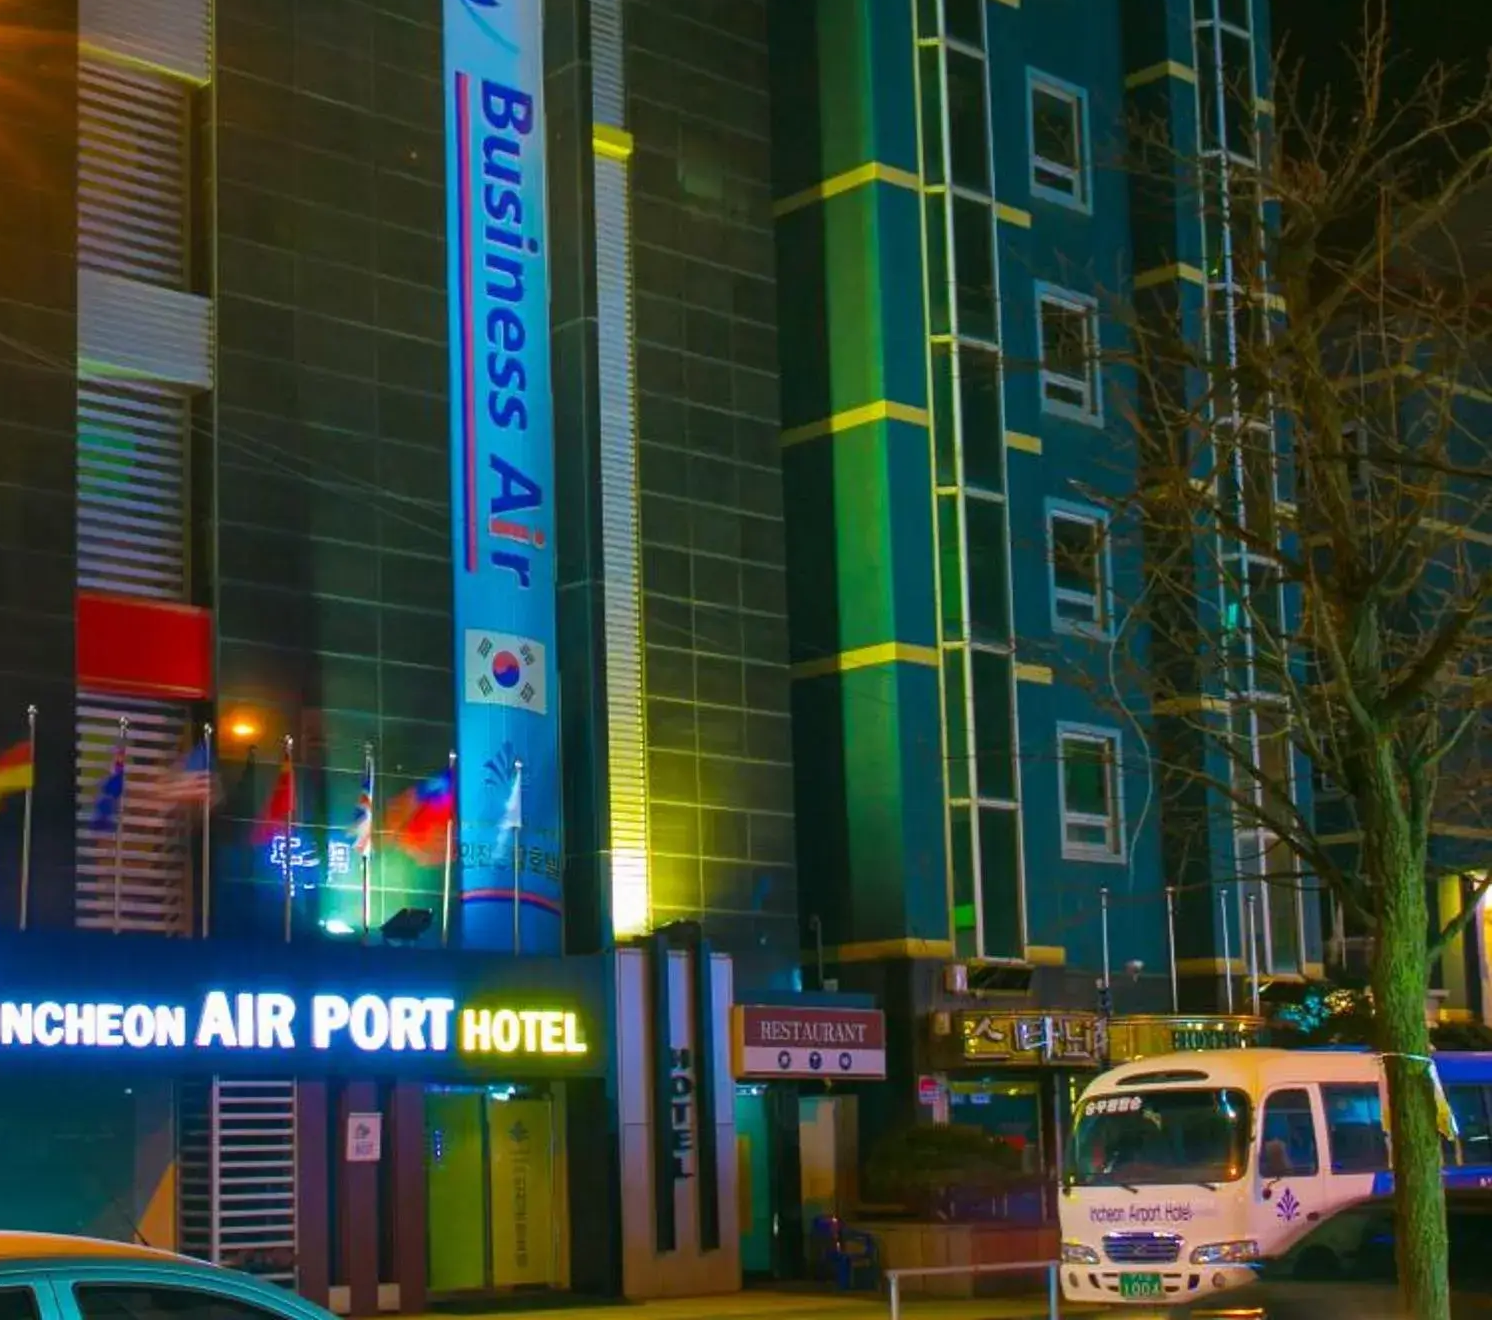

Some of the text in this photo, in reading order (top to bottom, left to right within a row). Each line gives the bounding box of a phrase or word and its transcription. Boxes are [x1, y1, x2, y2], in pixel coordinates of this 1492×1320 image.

[481, 77, 547, 589] Business Air
[195, 991, 296, 1049] AIR
[313, 994, 455, 1051] PORT
[462, 1008, 587, 1053] HOTEL
[760, 1020, 867, 1043] RESTAURANT
[671, 1048, 696, 1178] HOTEL
[1090, 1206, 1124, 1222] Incheon
[1129, 1204, 1161, 1226] Airport
